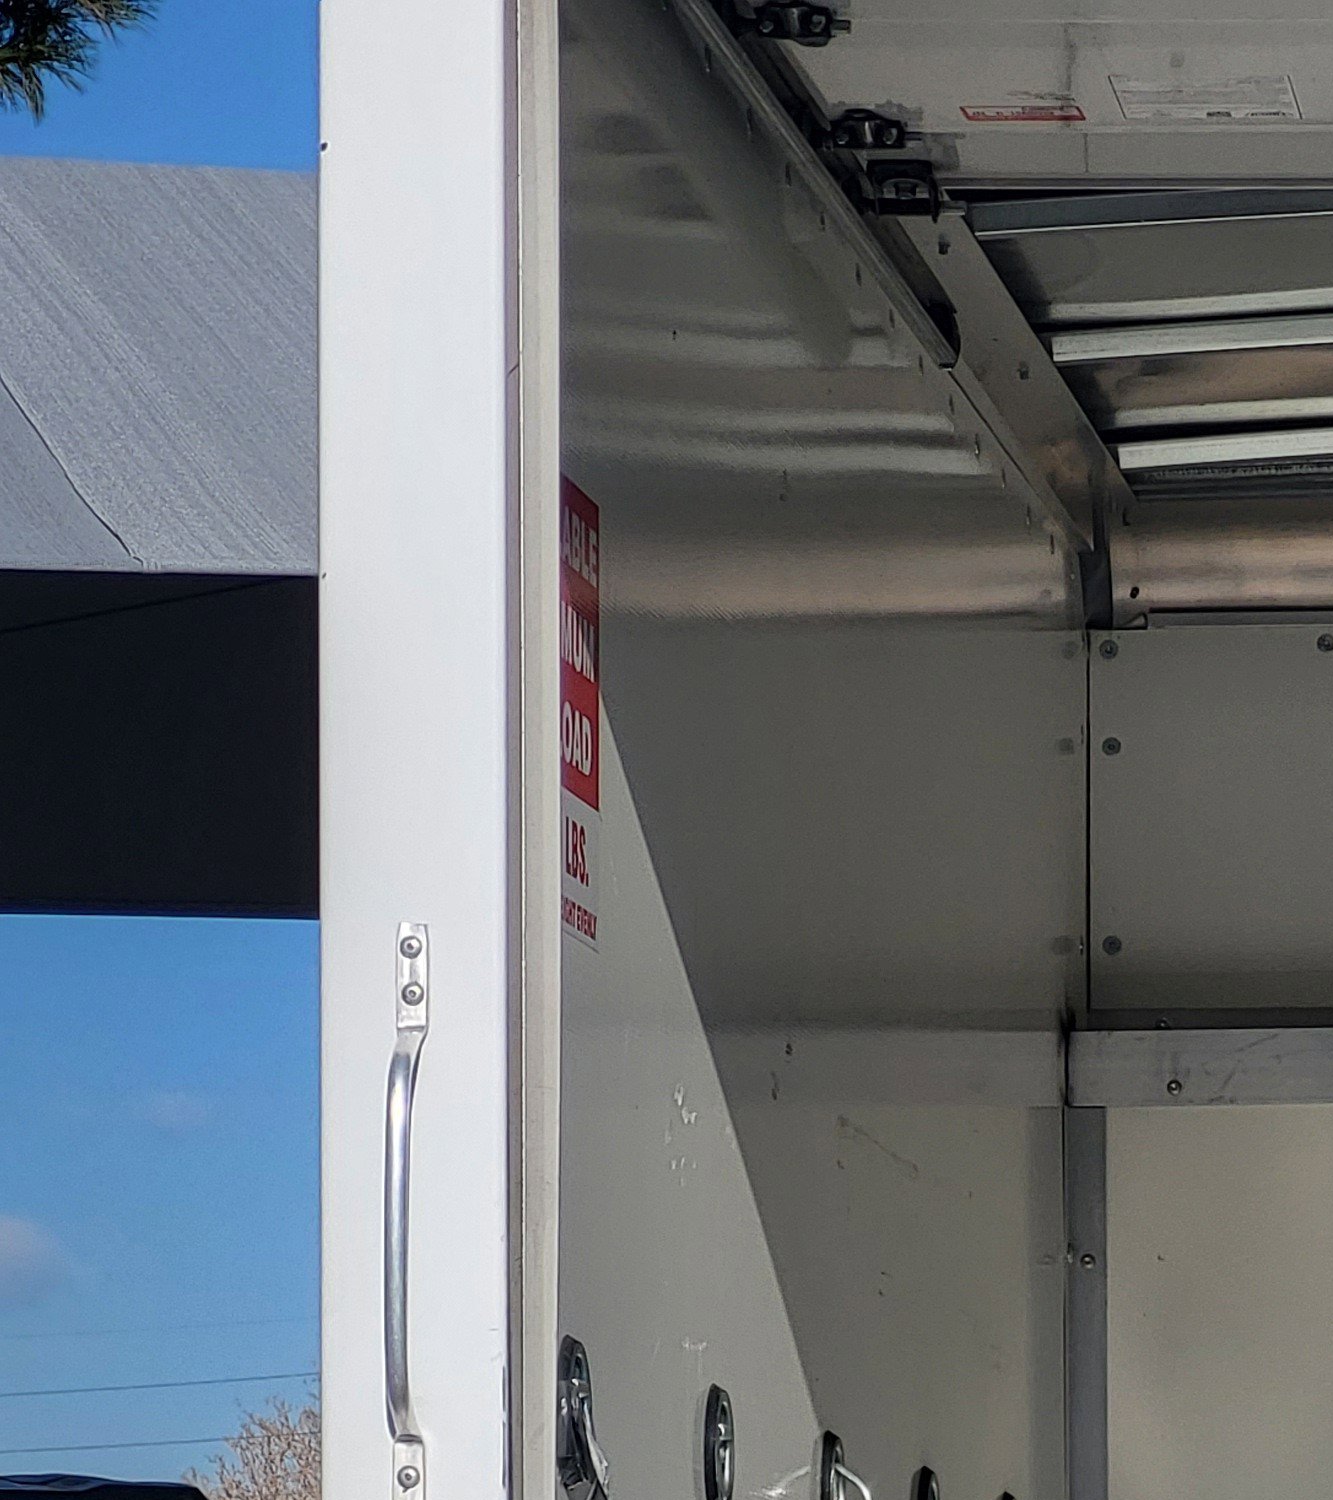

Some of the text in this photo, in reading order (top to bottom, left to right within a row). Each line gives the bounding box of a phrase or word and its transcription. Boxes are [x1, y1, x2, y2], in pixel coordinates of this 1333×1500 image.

[560, 505, 597, 588] ABLE
[561, 600, 595, 684] MUM
[560, 701, 592, 777] OAD
[565, 816, 589, 888] LBS.
